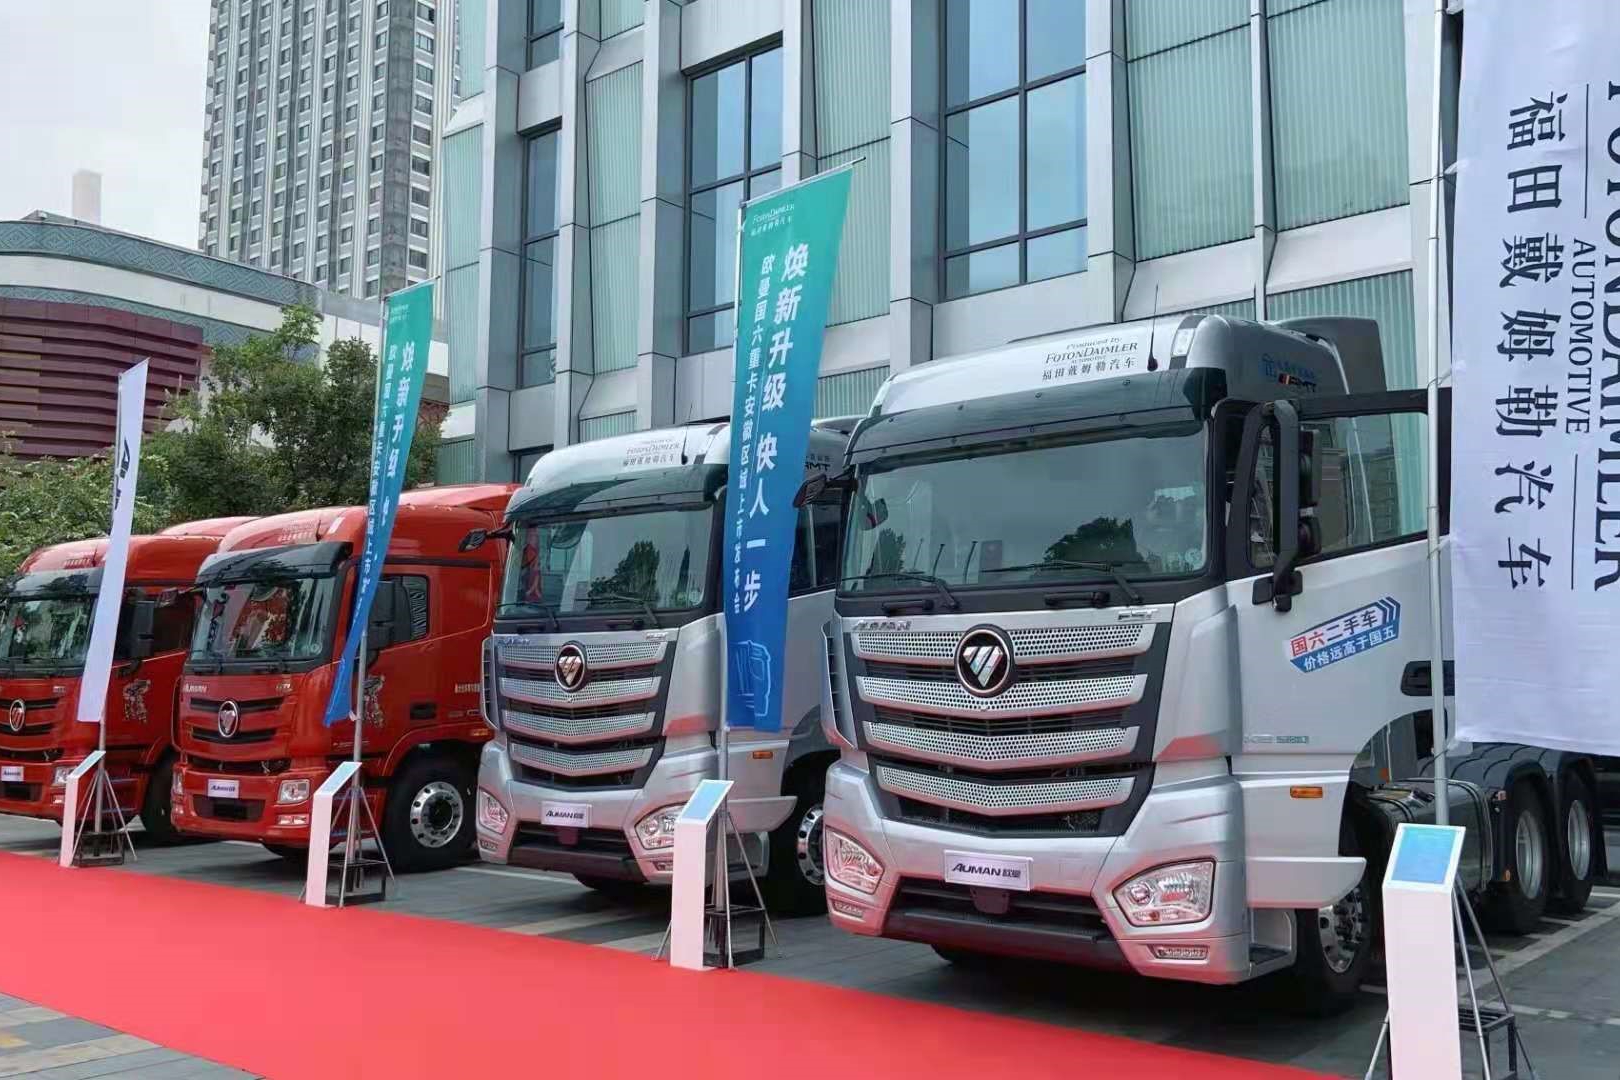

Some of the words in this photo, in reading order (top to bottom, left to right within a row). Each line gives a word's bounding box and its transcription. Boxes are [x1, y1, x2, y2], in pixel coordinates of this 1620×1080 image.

[761, 242, 810, 412] 焕新升级
[1495, 91, 1570, 592] 福田戴姆勒汽车
[1566, 238, 1597, 434] AUTOMOTIVE
[743, 434, 778, 613] 快人一步
[1290, 609, 1378, 657] 国六二手车
[1303, 624, 1397, 671] 价格远高于国五
[952, 863, 1001, 877] AUMAN
